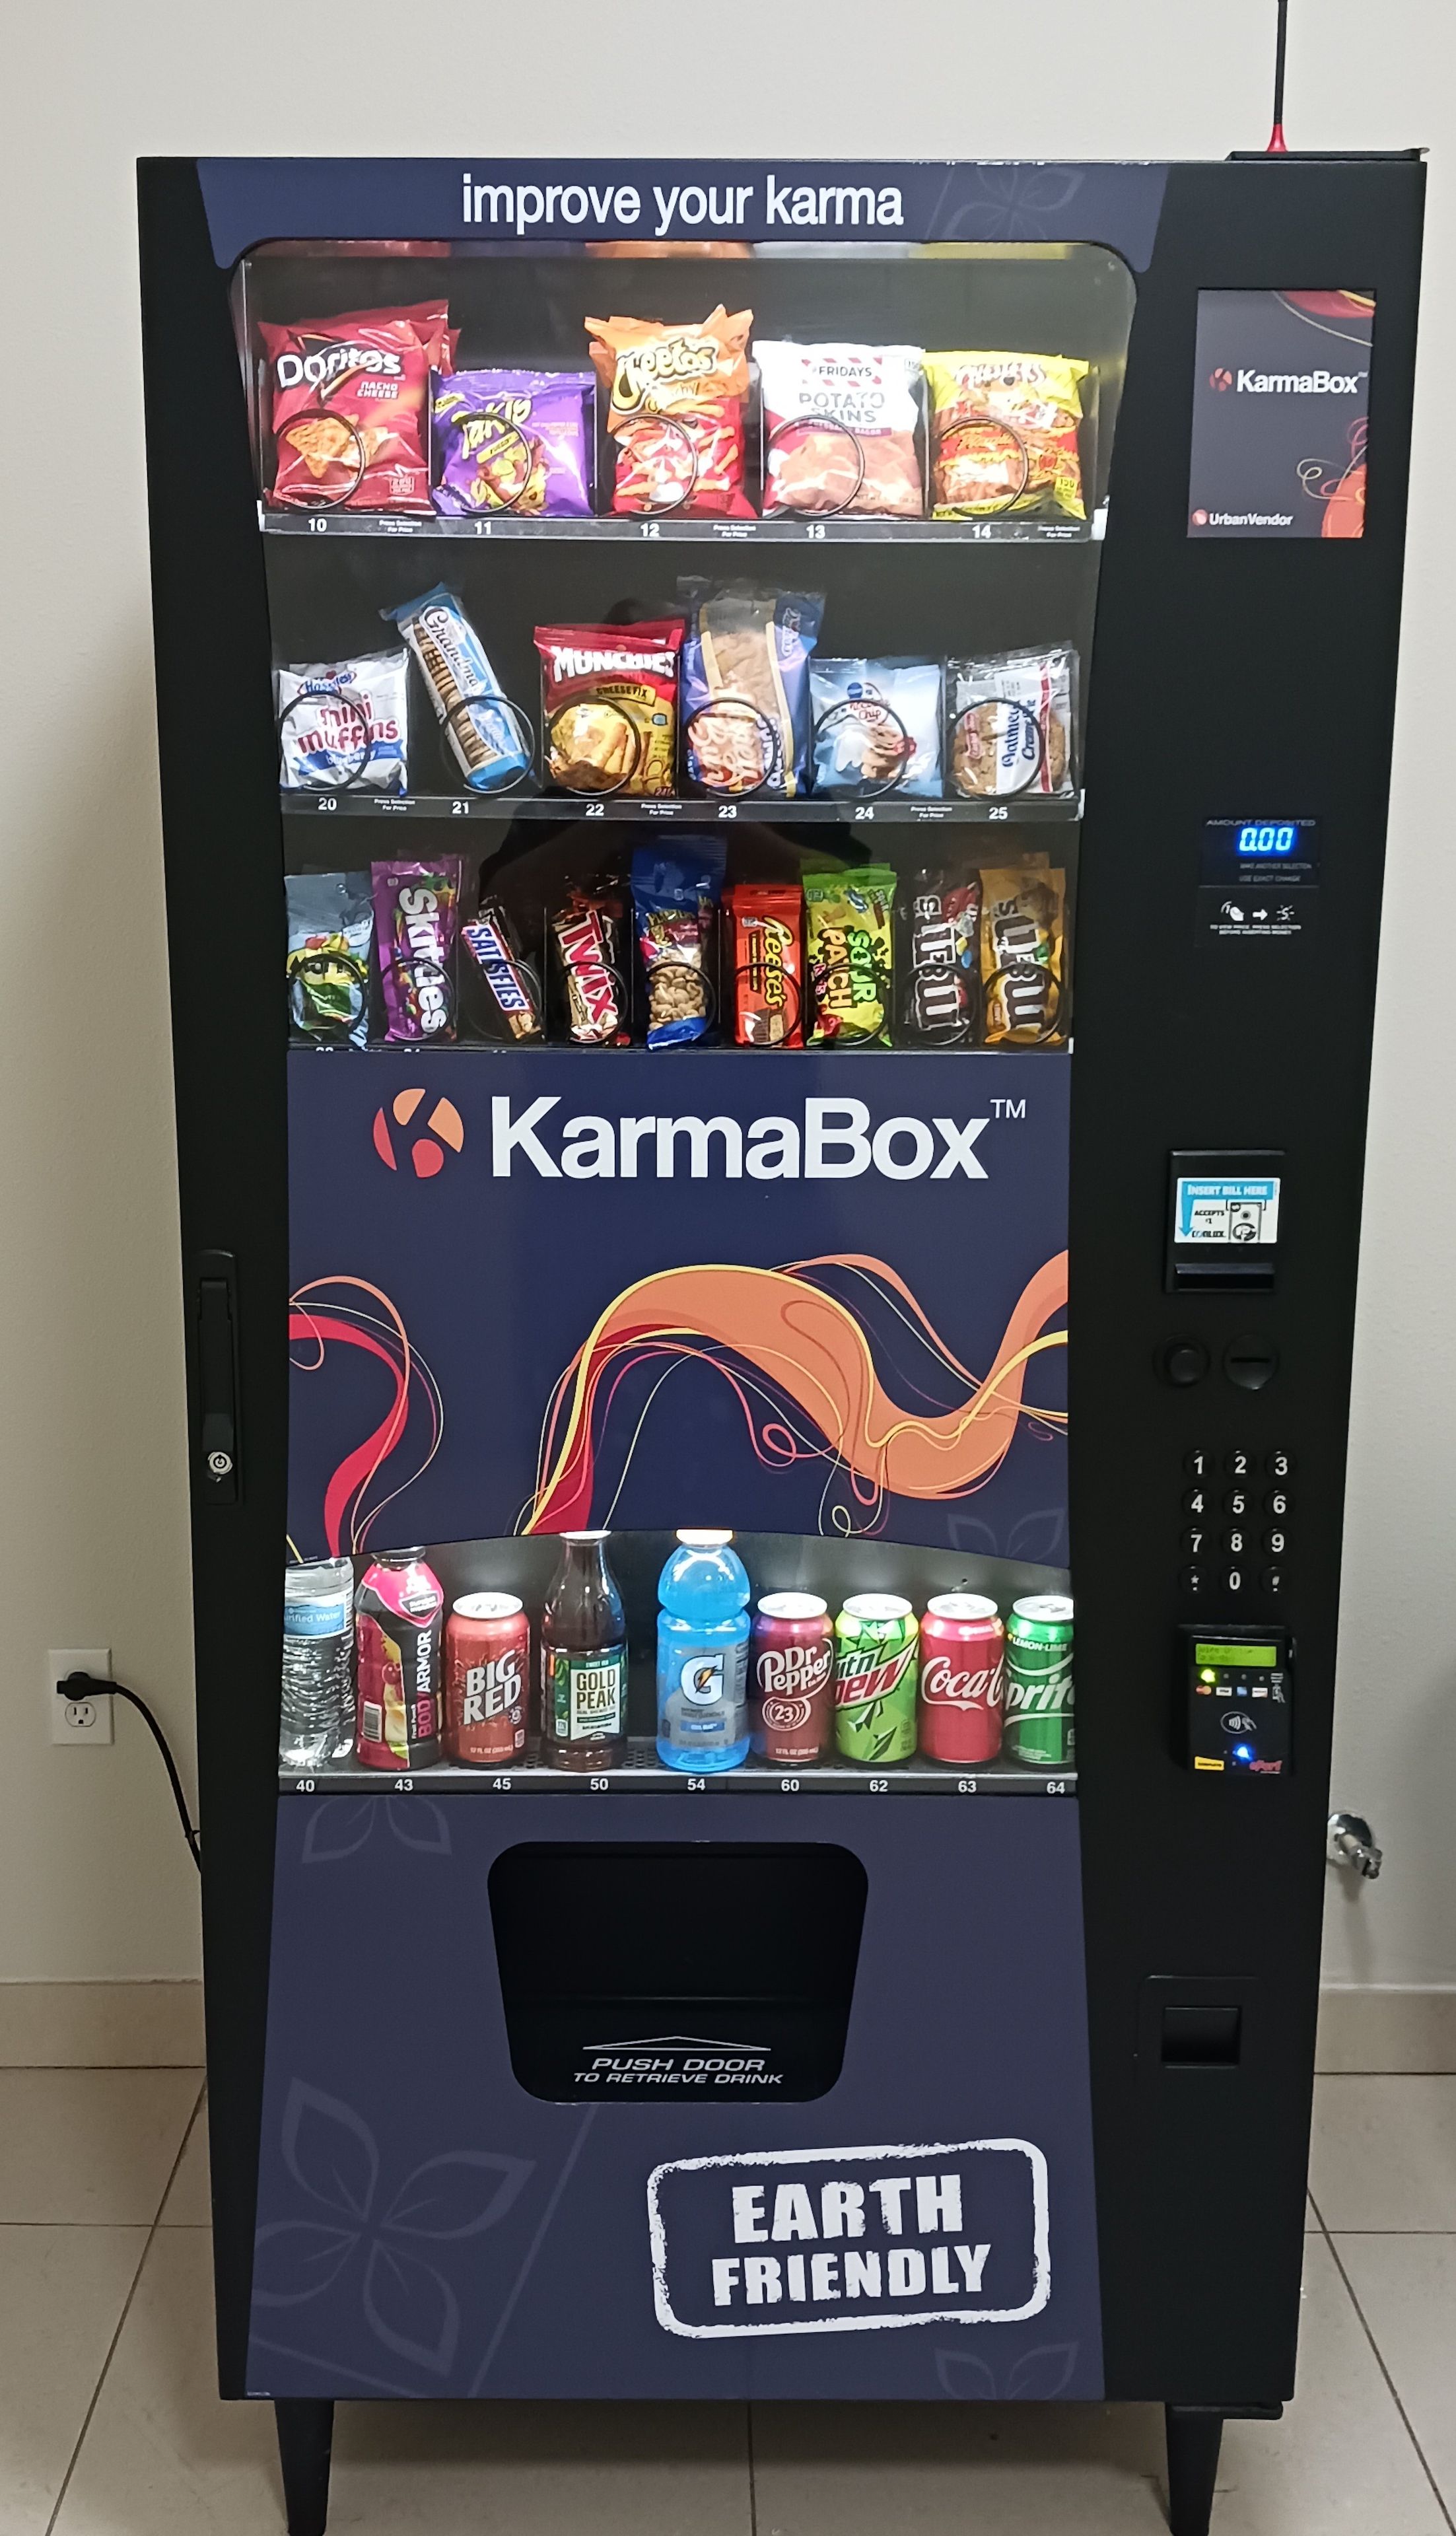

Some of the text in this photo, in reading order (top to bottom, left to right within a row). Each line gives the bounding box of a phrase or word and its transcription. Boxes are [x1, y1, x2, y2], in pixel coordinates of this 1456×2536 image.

[464, 174, 903, 236] improve your karma
[277, 348, 401, 388] Doritos
[819, 367, 872, 376] FRIDAYS
[1237, 369, 1358, 394] KarmaBox
[799, 392, 885, 408] POTATO
[308, 518, 327, 532] 10
[1209, 512, 1293, 526] UrbanVendor
[474, 521, 491, 534] 11
[641, 523, 660, 537] 12
[806, 525, 825, 539] 13
[972, 525, 991, 538] 14
[318, 798, 337, 810] 20
[452, 801, 469, 814] 21
[586, 804, 604, 816] 22
[718, 806, 737, 818] 23
[855, 807, 874, 820] 24
[989, 807, 1008, 820] 25
[1239, 828, 1294, 852] 0.00
[468, 927, 525, 1009] SATISFIES
[491, 1096, 990, 1179] KarmaBox
[1187, 1185, 1221, 1195] INSERT
[1194, 1456, 1204, 1474] 1
[1235, 1456, 1247, 1473] 2
[1274, 1456, 1288, 1475] 3
[1191, 1495, 1204, 1512] 4
[1233, 1495, 1245, 1514] 5
[1273, 1495, 1286, 1514] 6
[1191, 1534, 1202, 1553] 7
[1231, 1533, 1243, 1552] 8
[1271, 1533, 1284, 1552] 9
[1229, 1572, 1241, 1590] 0
[784, 1646, 817, 1672] Dr
[466, 1649, 516, 1697] BIG
[576, 1669, 615, 1691] GOLD
[681, 1654, 725, 1706] G
[758, 1650, 831, 1695] Pepper
[464, 1674, 522, 1726] RED
[576, 1687, 615, 1709] PEAK
[774, 1705, 794, 1722] 23
[296, 1780, 315, 1792] 40
[395, 1779, 413, 1791] 43
[493, 1778, 512, 1790] 45
[590, 1779, 609, 1790] 50
[687, 1779, 706, 1790] 54
[781, 1779, 800, 1792] 60
[870, 1780, 888, 1792] 62
[958, 1780, 977, 1792] 63
[1047, 1782, 1065, 1794] 64
[592, 2059, 765, 2071] PUSH DOOR
[574, 2072, 784, 2084] TO RETRIEVE DRINK
[732, 2174, 963, 2243] EARTH
[712, 2244, 991, 2306] FRIENDLY
